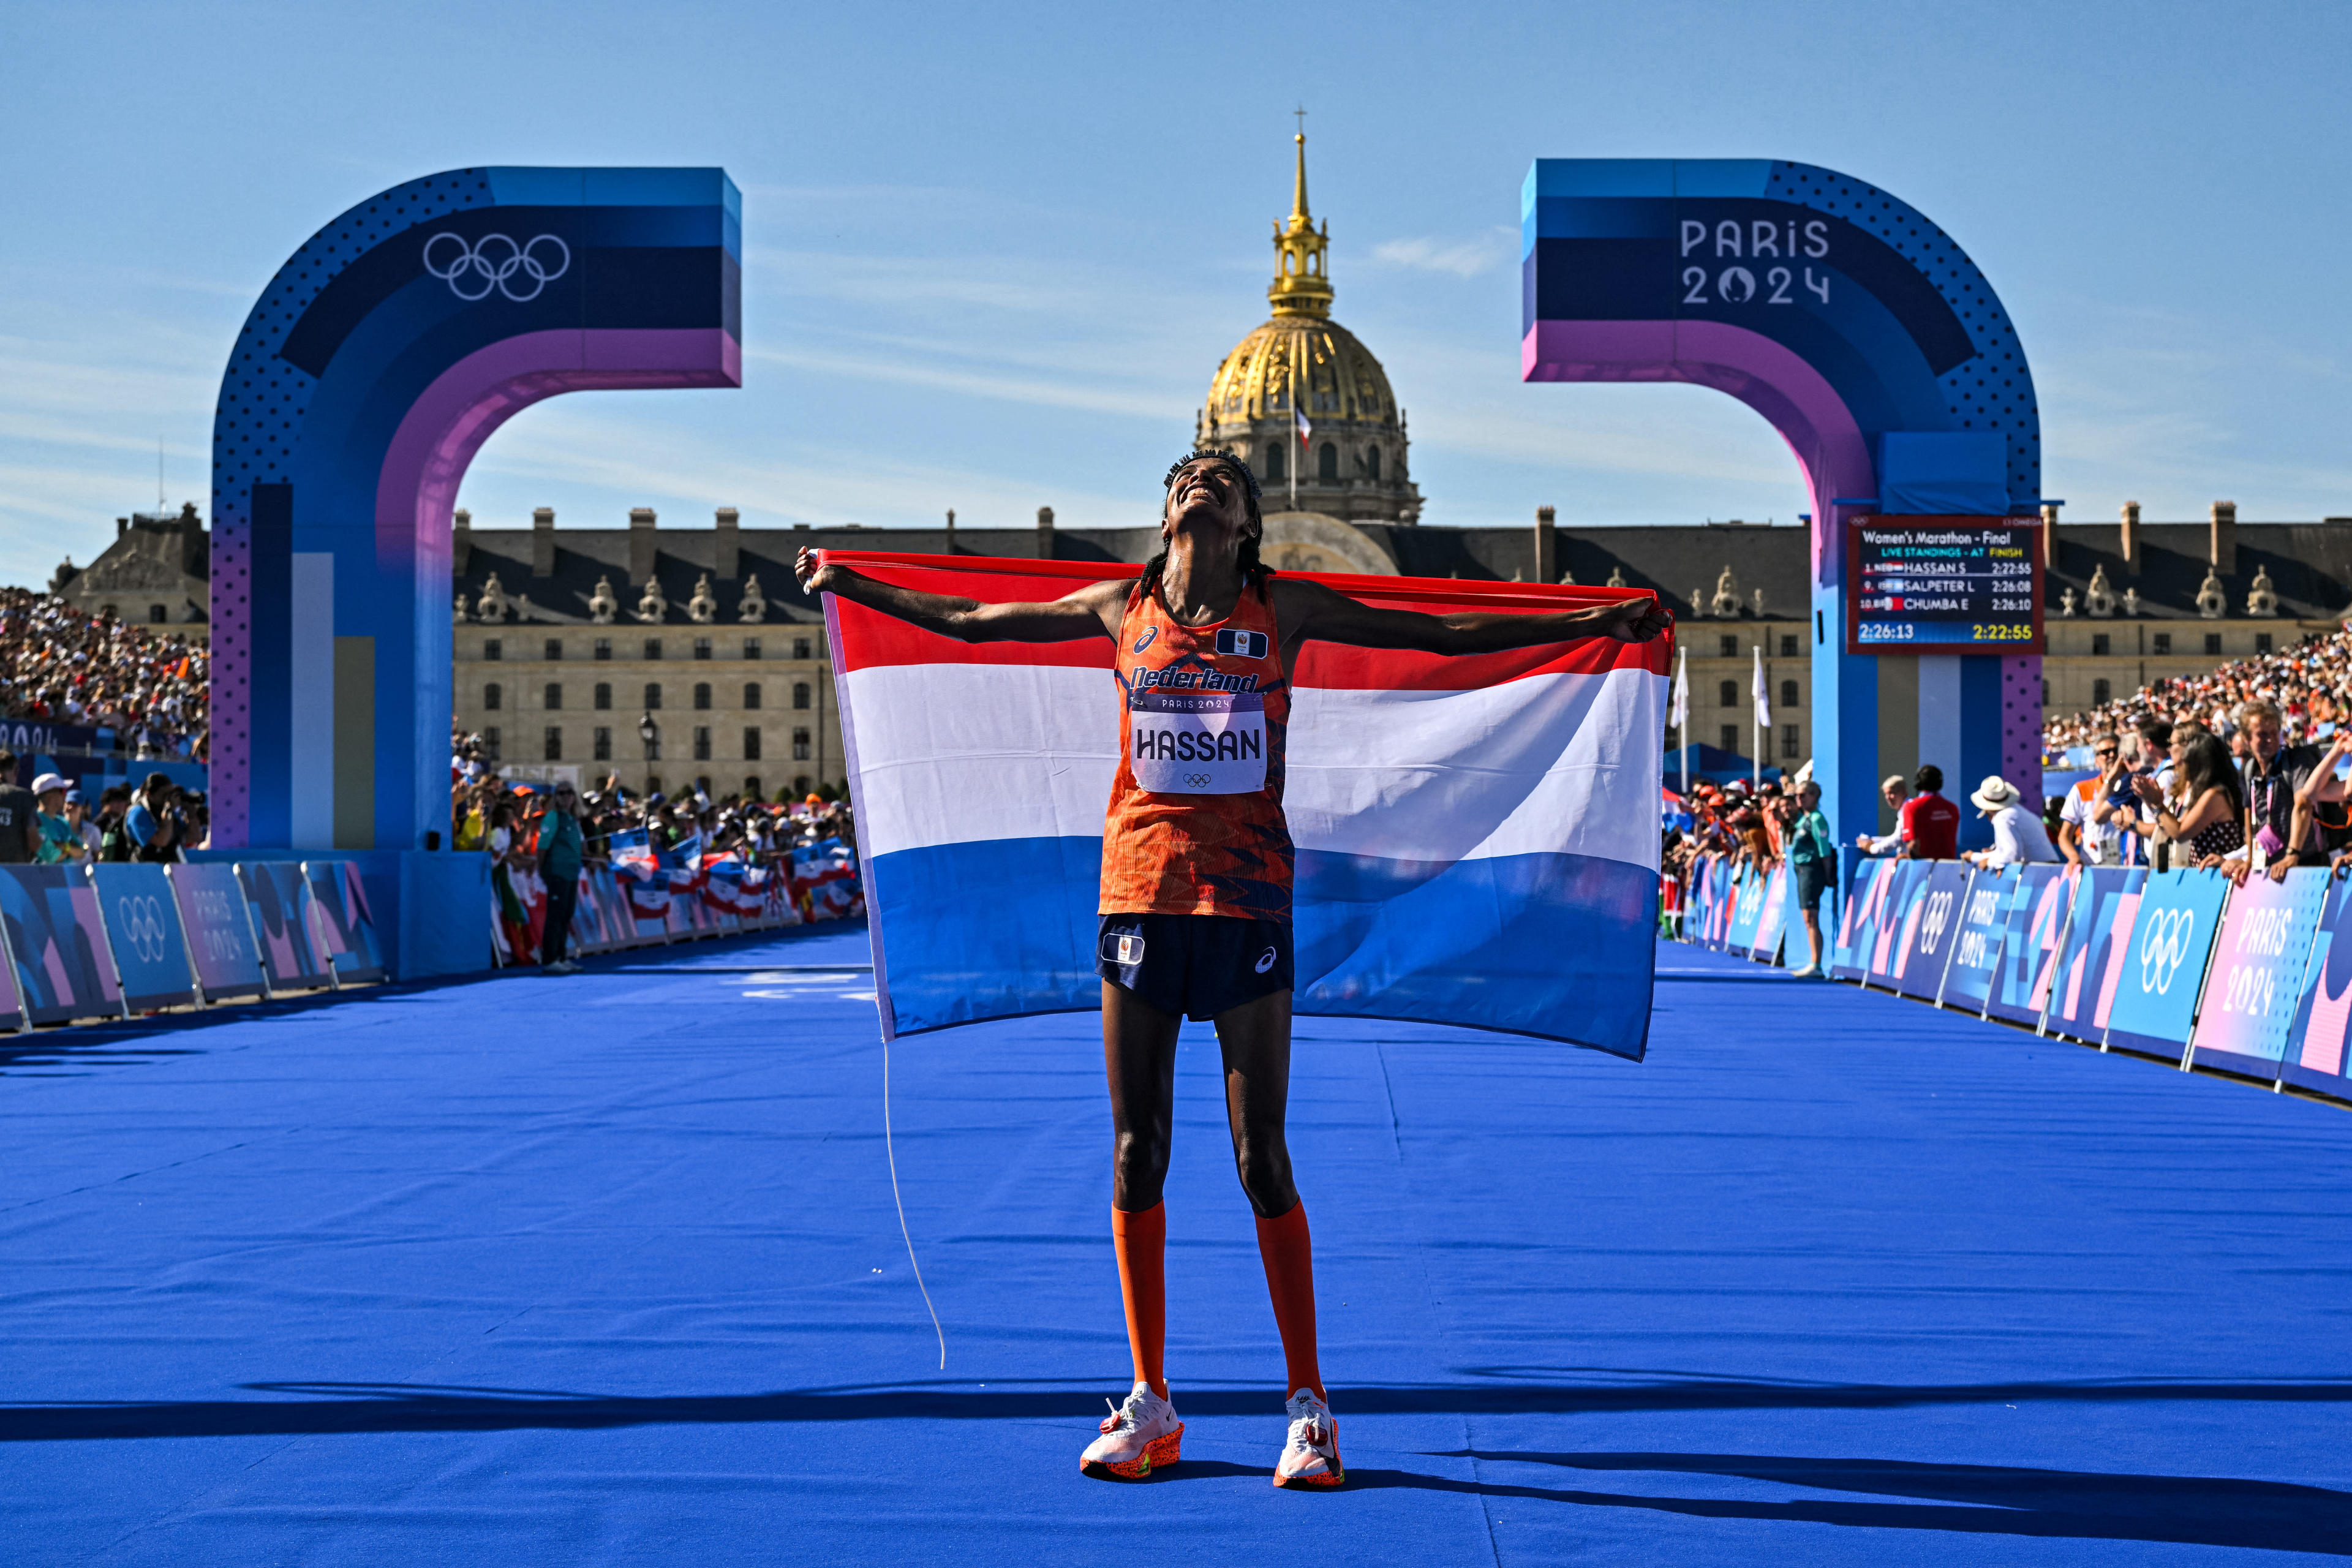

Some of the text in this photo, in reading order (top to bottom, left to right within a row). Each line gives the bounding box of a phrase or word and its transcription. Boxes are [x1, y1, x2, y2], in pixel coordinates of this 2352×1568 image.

[1682, 266, 1830, 304] 2024
[1862, 530, 1913, 544] Women's
[1915, 530, 1972, 545] Marathon
[1982, 530, 2011, 545] Final
[1881, 548, 1902, 557] LIVE
[1904, 548, 1961, 557] STANDINGS
[1970, 548, 1985, 557] AT
[1989, 548, 2022, 557] FINISH
[1904, 562, 1956, 574] HASSAN
[1958, 562, 1966, 574] S
[1992, 562, 2032, 575] 2:22:55
[1904, 580, 1965, 592] SALPETER
[1967, 581, 1975, 592] L
[1992, 580, 2032, 592] 2:26:08
[1904, 598, 1959, 610] CHUMBA
[1961, 598, 1969, 610] E
[1992, 598, 2032, 611] 2:26:10
[1860, 624, 1913, 639] 2:26:13
[1973, 624, 2032, 639] 2:22:55
[1198, 699, 1229, 709] 2024
[1137, 729, 1260, 761] HASSAN
[2222, 964, 2275, 1017] 2024
